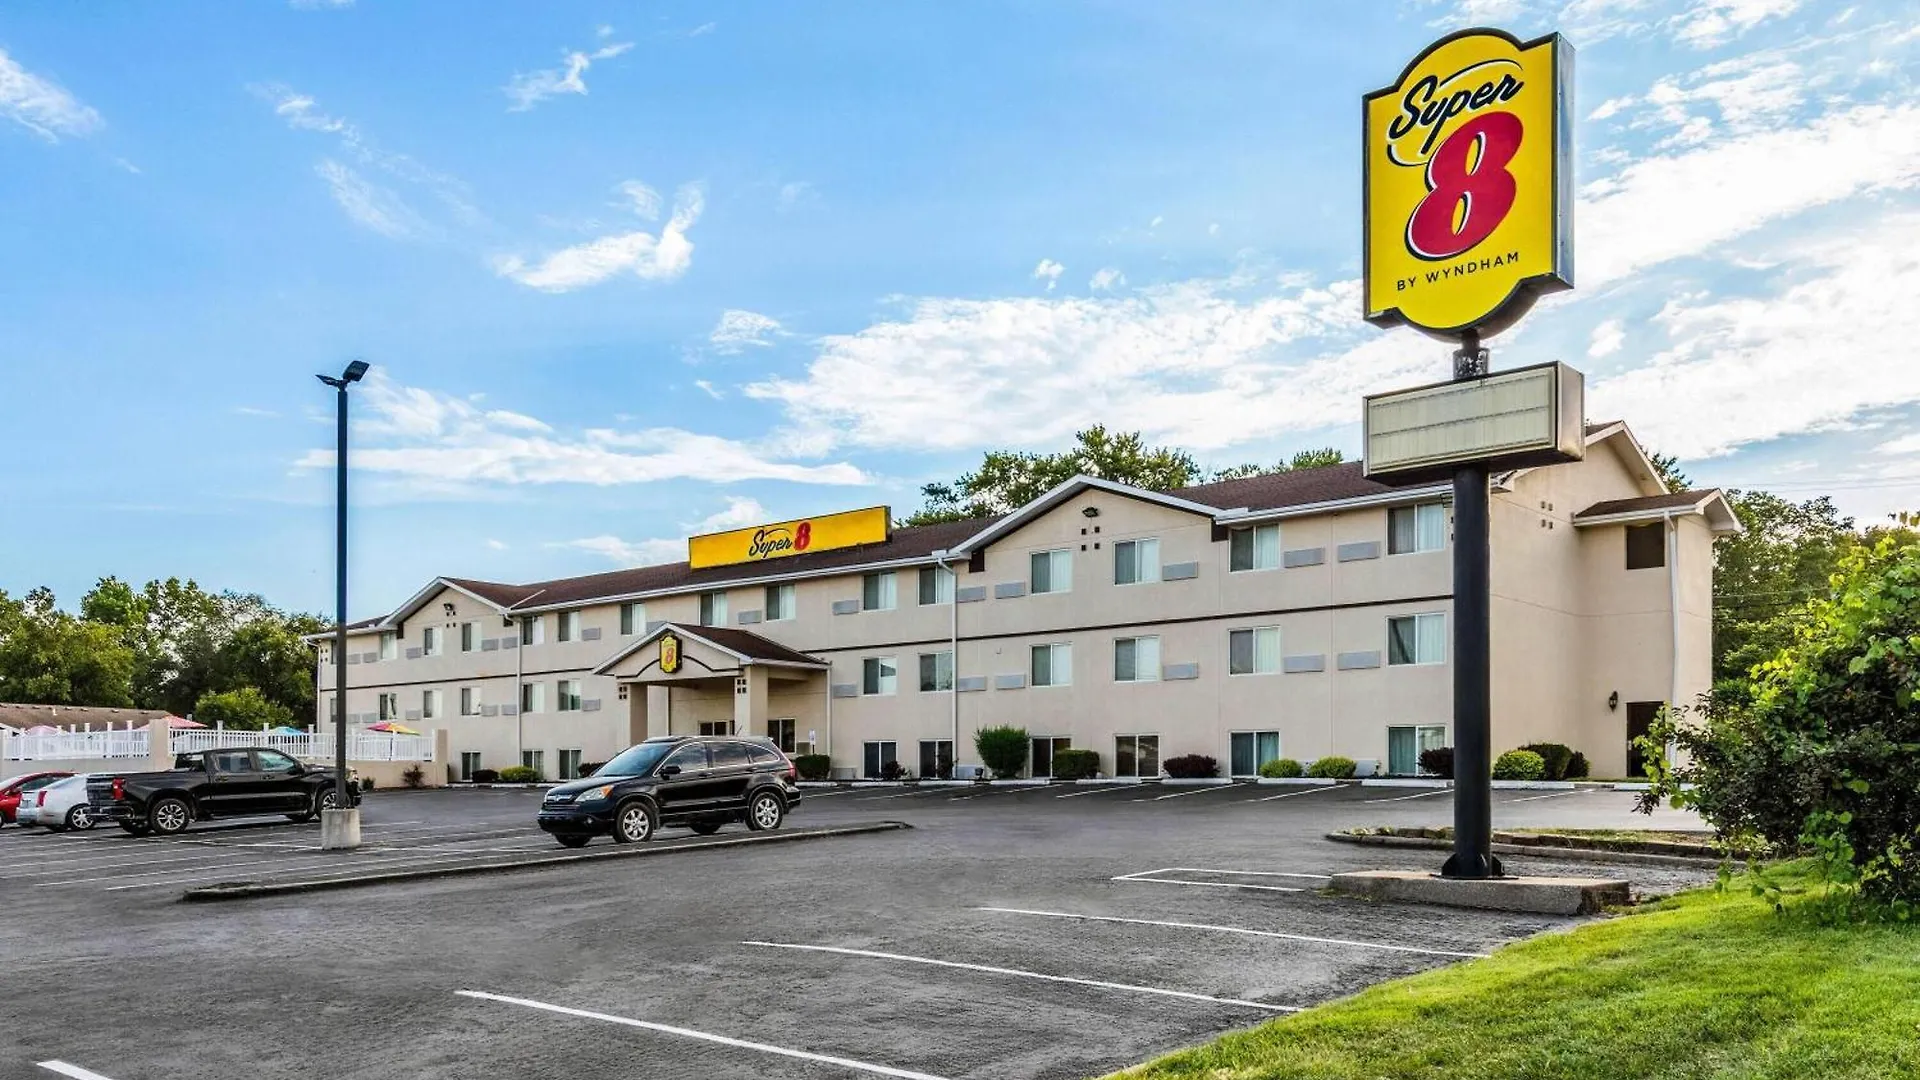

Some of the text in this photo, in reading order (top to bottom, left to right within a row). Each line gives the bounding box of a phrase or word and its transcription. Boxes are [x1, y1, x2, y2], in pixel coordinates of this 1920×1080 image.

[1388, 73, 1525, 156] Super
[1404, 111, 1524, 261] 8
[1397, 251, 1519, 291] BY WYNDHAM
[748, 521, 811, 559] Super 8
[665, 647, 675, 665] 8
